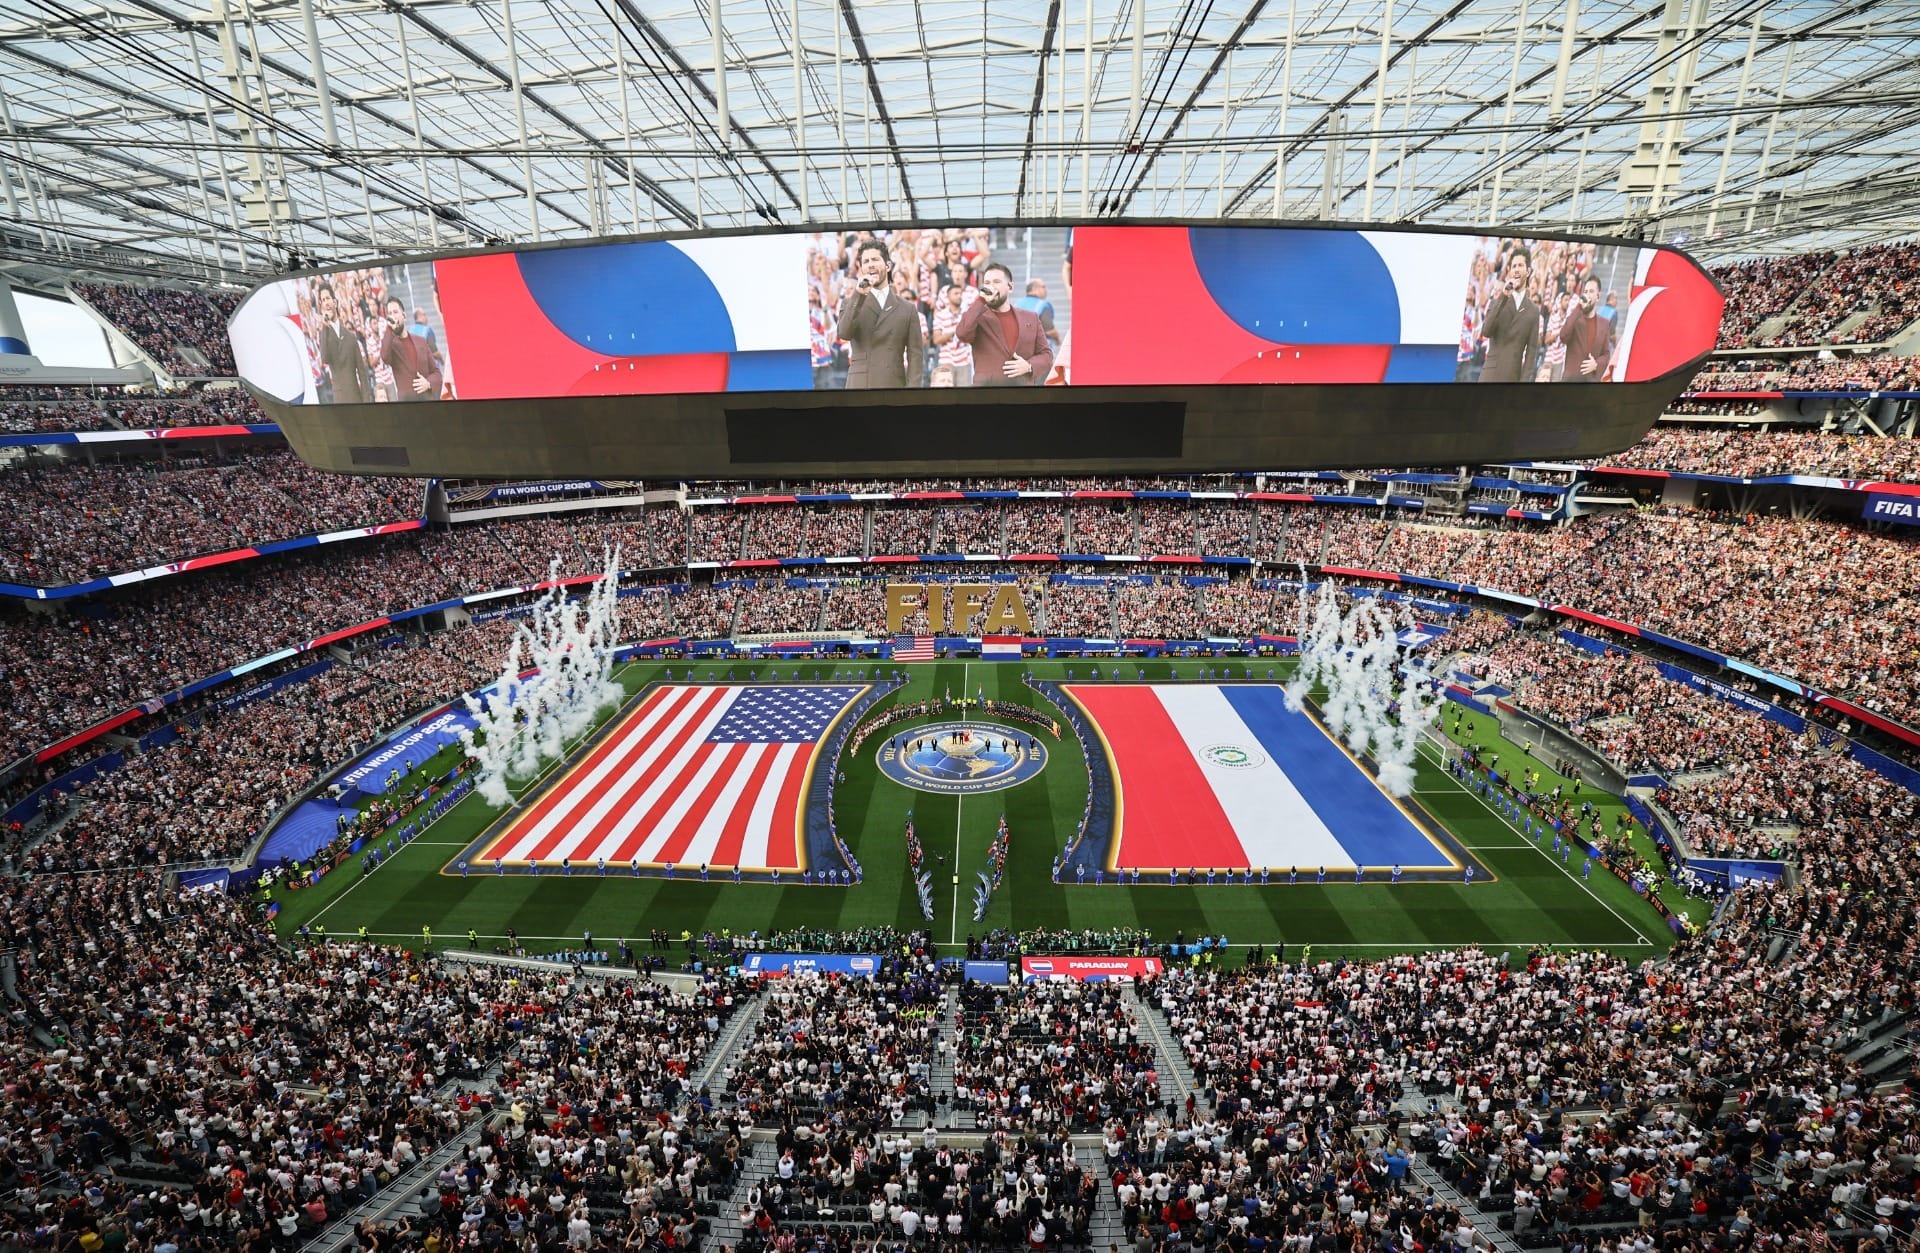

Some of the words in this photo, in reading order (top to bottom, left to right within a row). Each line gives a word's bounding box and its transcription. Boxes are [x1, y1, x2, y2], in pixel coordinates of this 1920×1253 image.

[497, 488, 516, 496] FIFA
[517, 485, 546, 494] WORLD
[564, 481, 591, 490] 2026
[1874, 501, 1912, 517] FIFA
[480, 611, 492, 619] FIFA
[887, 583, 1033, 632] FIFA
[1692, 675, 1706, 685] FIFA
[1730, 690, 1745, 700] CUP
[1744, 696, 1771, 711] 2026
[343, 767, 374, 783] FIFA
[366, 742, 406, 768] WORLD
[403, 732, 423, 746] CUP
[421, 714, 456, 734] 2026
[904, 776, 923, 785] FIFA
[984, 776, 1016, 787] 2026
[316, 864, 331, 878] FIFA
[1614, 866, 1629, 883] FIFA
[1651, 896, 1663, 912] FIFA
[794, 959, 816, 967] USA
